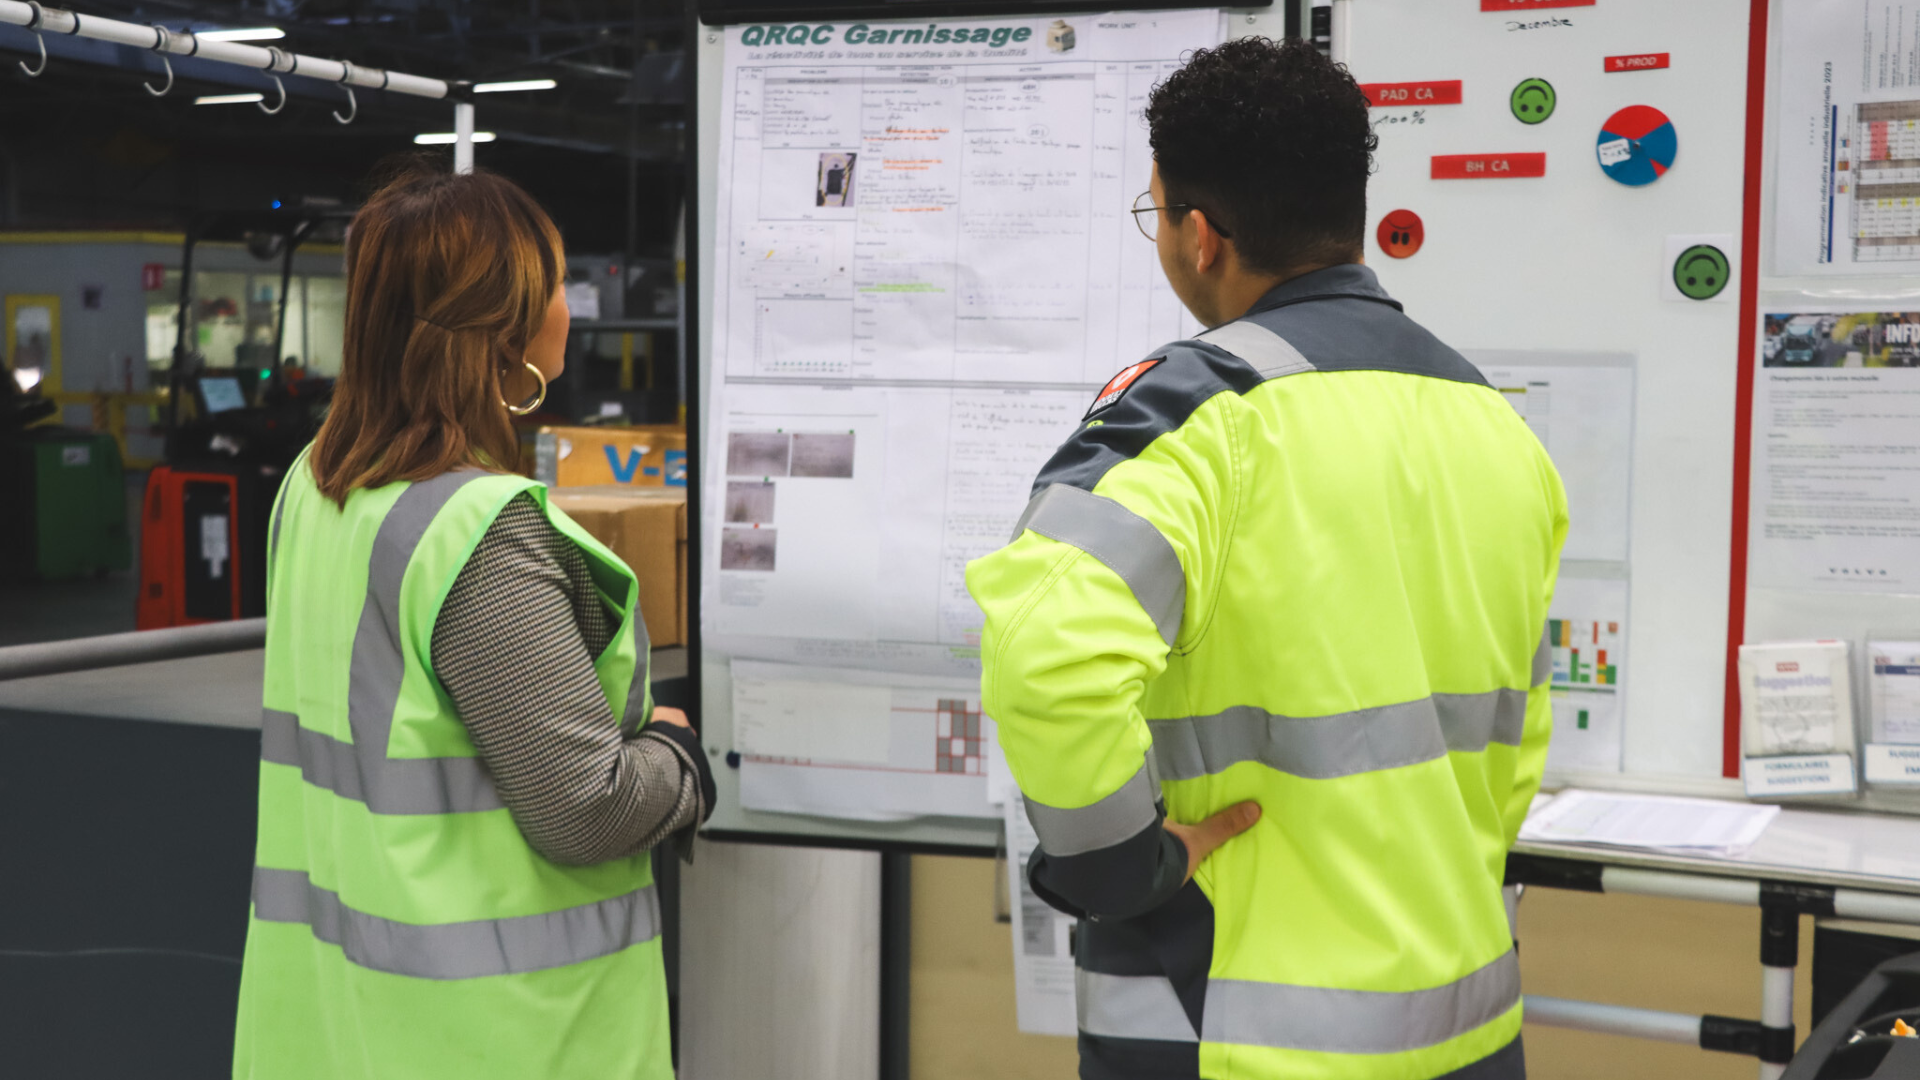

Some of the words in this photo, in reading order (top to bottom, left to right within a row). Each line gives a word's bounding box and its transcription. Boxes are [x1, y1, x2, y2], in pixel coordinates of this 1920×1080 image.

[741, 25, 835, 46] QRQC
[843, 22, 1032, 48] Garnissage
[1615, 60, 1625, 68] %
[1627, 57, 1657, 67] PROD
[1824, 61, 1833, 83] 2023
[1379, 88, 1408, 101] PAD
[1415, 87, 1434, 100] CA
[1823, 85, 1832, 129] industrielle
[1822, 130, 1831, 163] annuelle
[1465, 161, 1485, 173] BH
[1491, 160, 1511, 172] CA
[1820, 165, 1830, 202] indicative
[1818, 204, 1828, 263] Programmation
